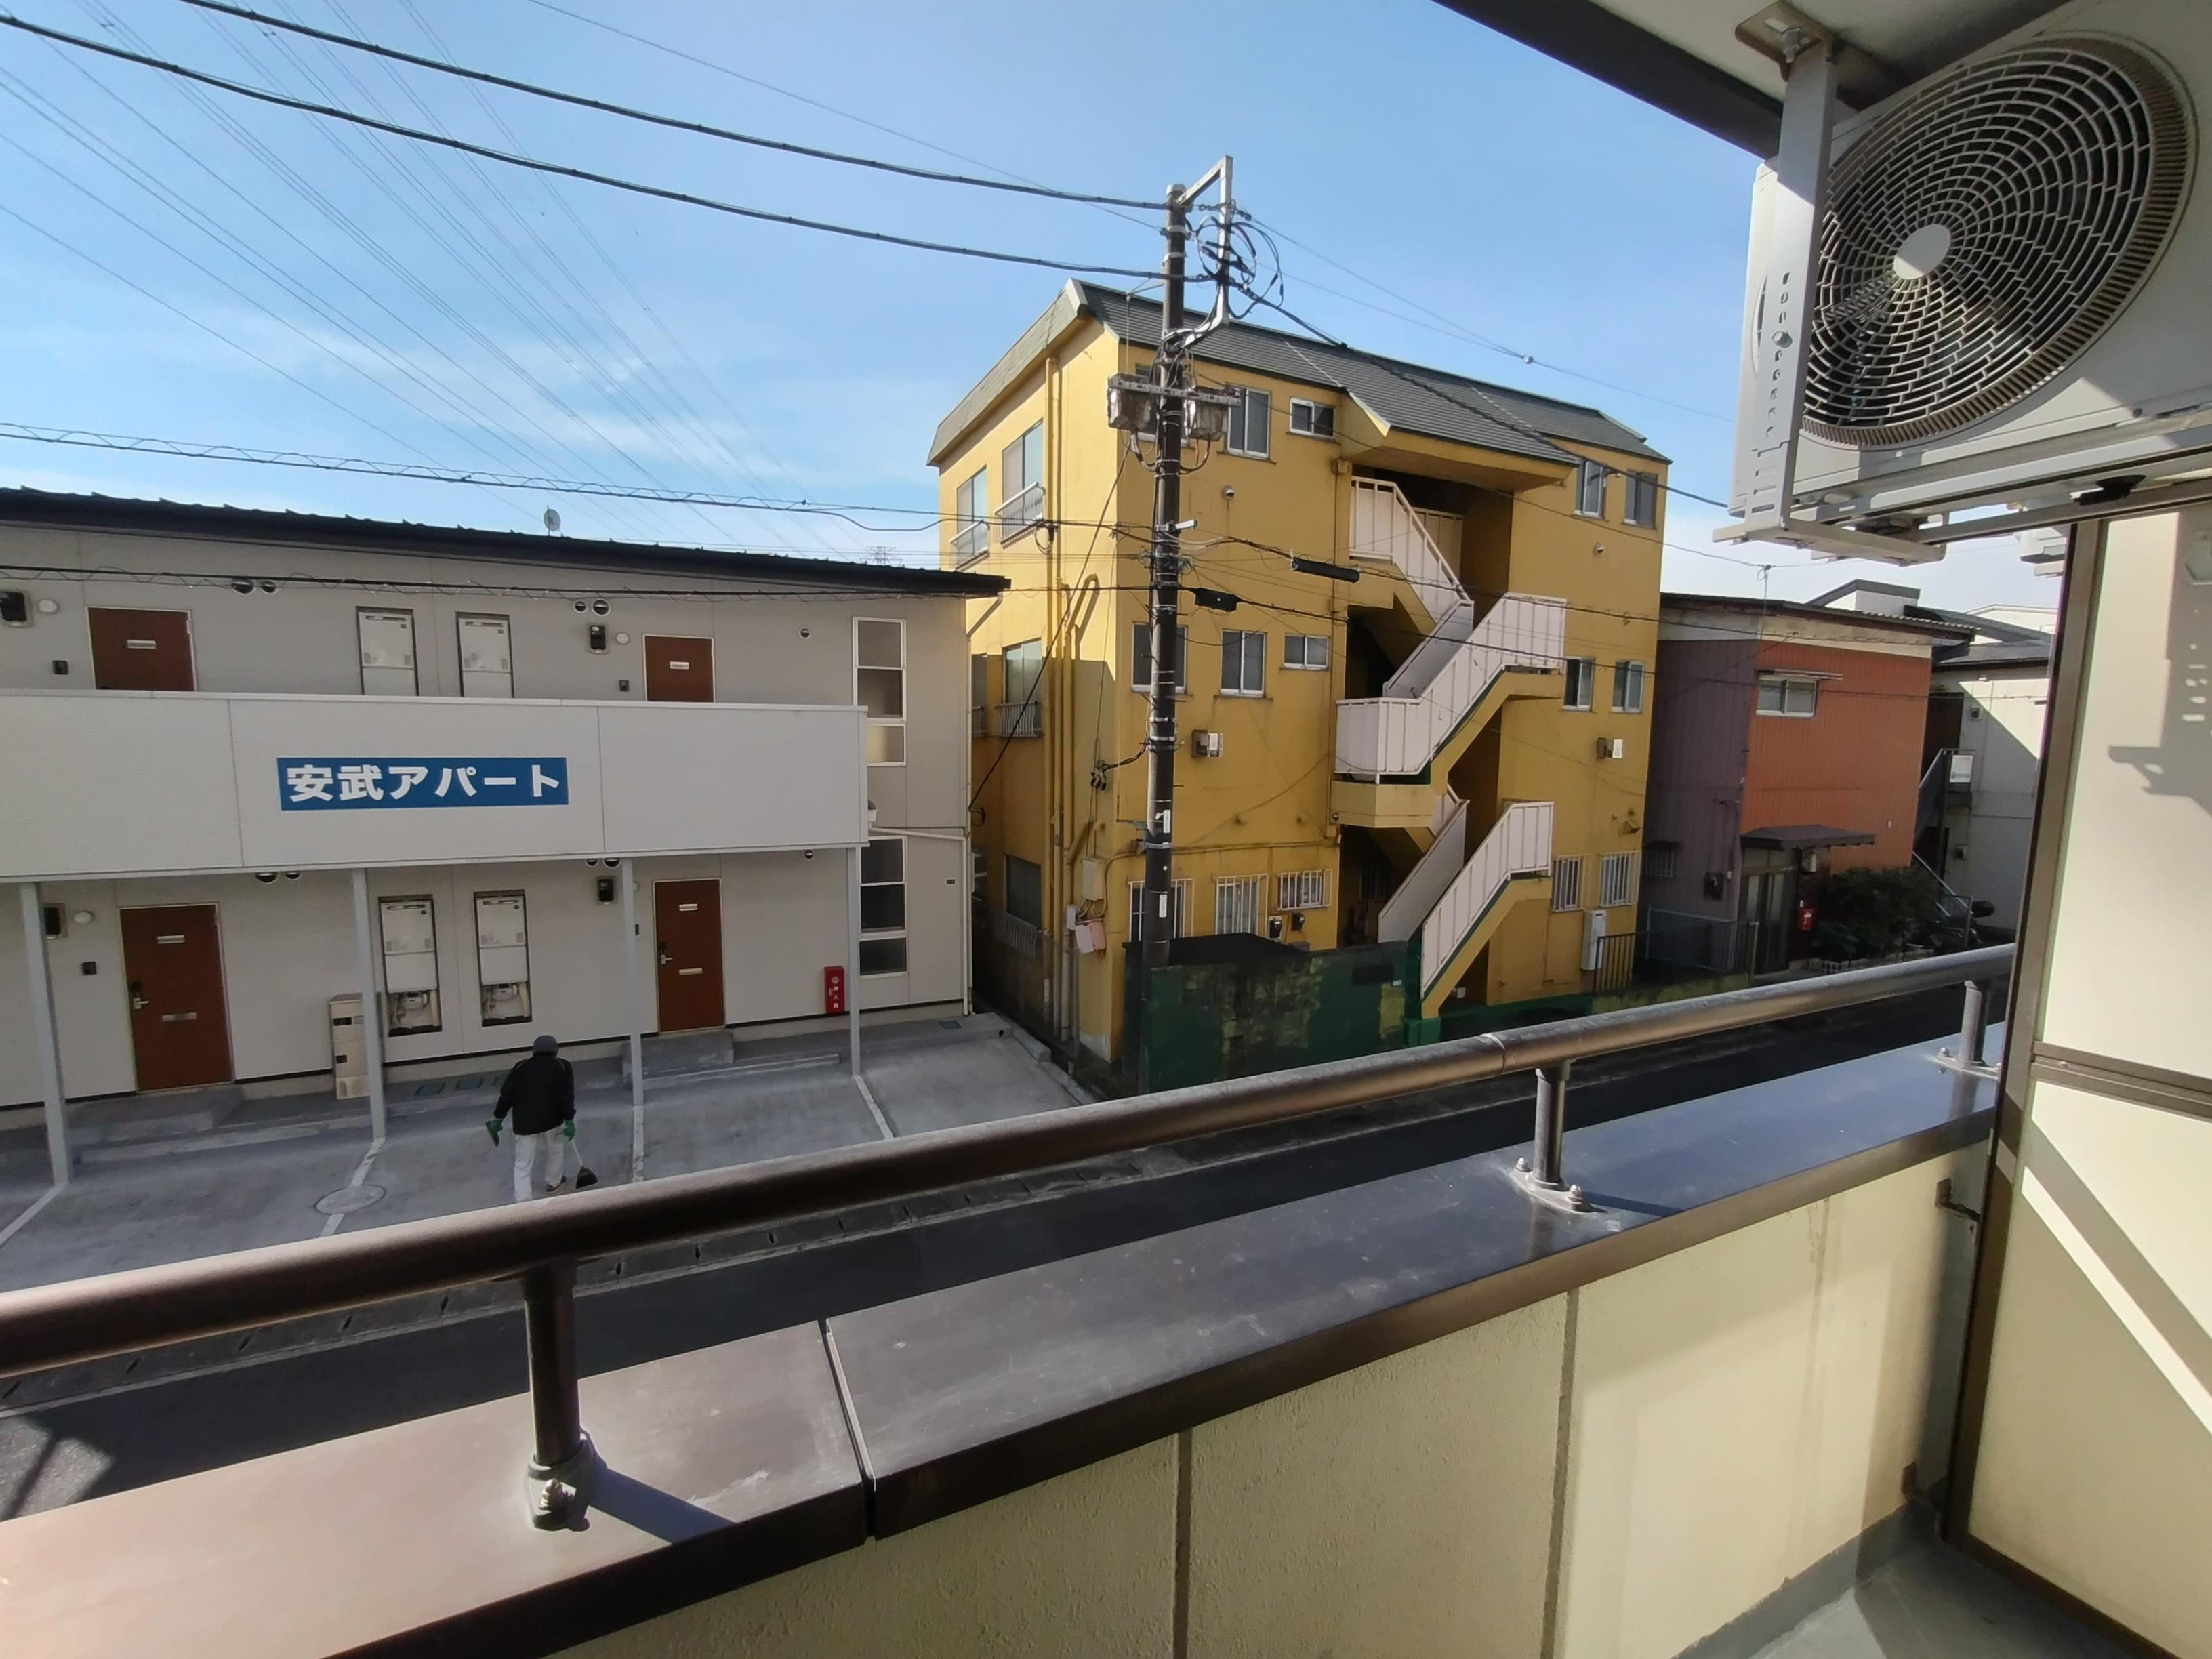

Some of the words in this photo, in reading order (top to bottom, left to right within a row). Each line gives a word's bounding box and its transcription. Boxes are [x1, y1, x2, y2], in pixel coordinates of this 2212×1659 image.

[286, 764, 560, 802] 安武アパート
